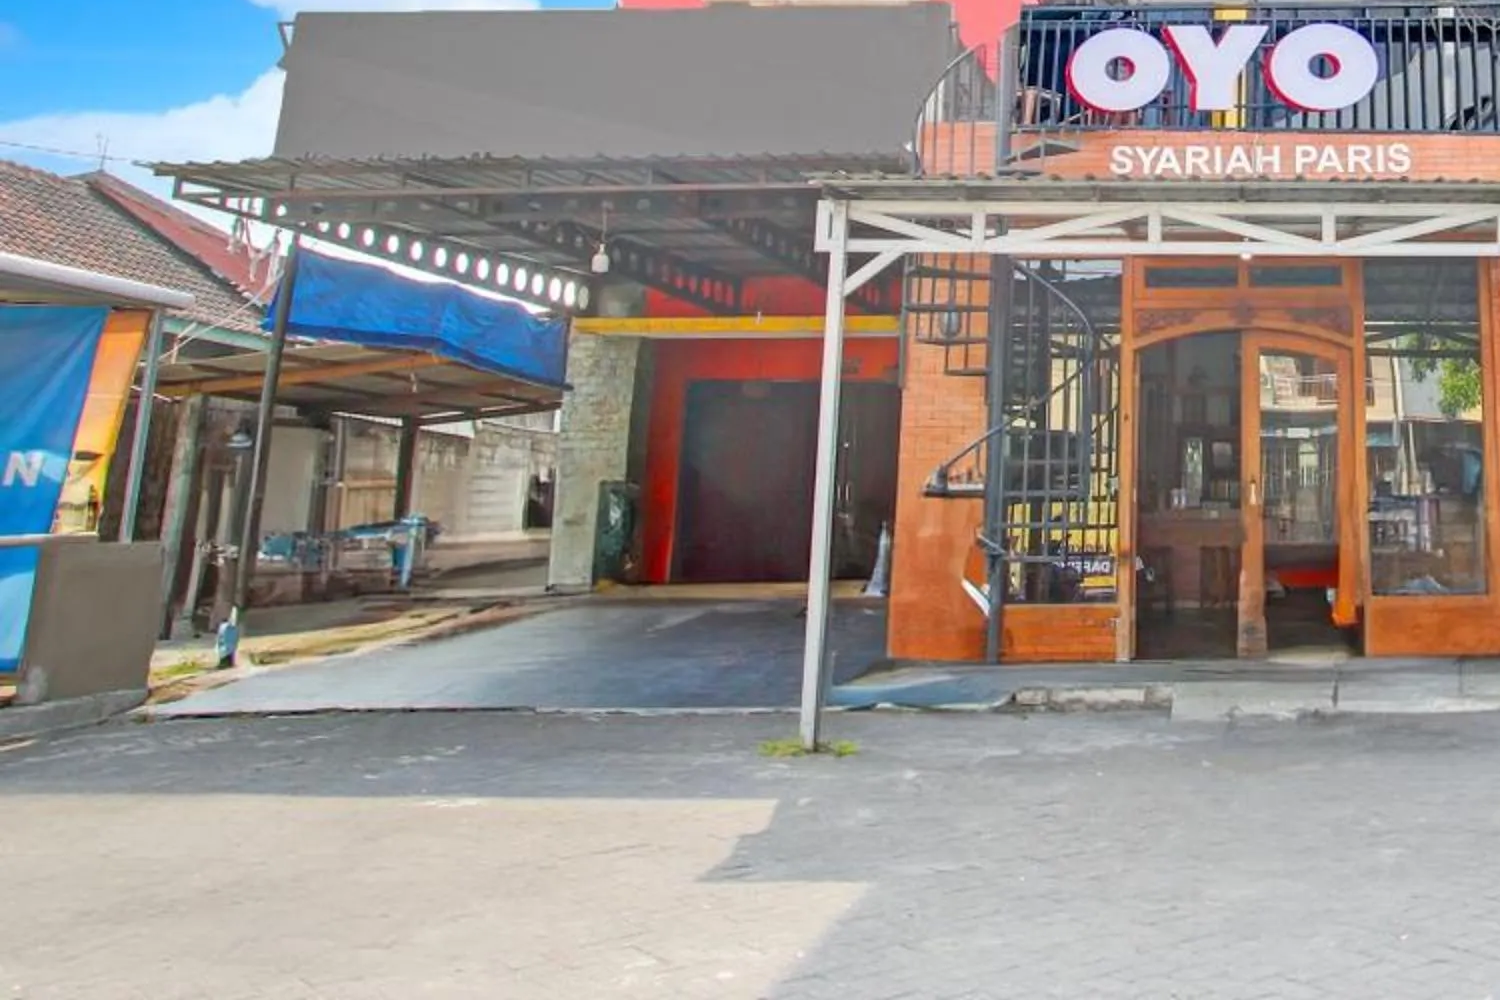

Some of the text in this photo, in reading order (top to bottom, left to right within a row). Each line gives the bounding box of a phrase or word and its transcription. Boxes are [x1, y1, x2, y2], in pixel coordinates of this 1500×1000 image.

[1065, 22, 1379, 112] OYO
[1109, 143, 1412, 175] SYARIAH PARIS
